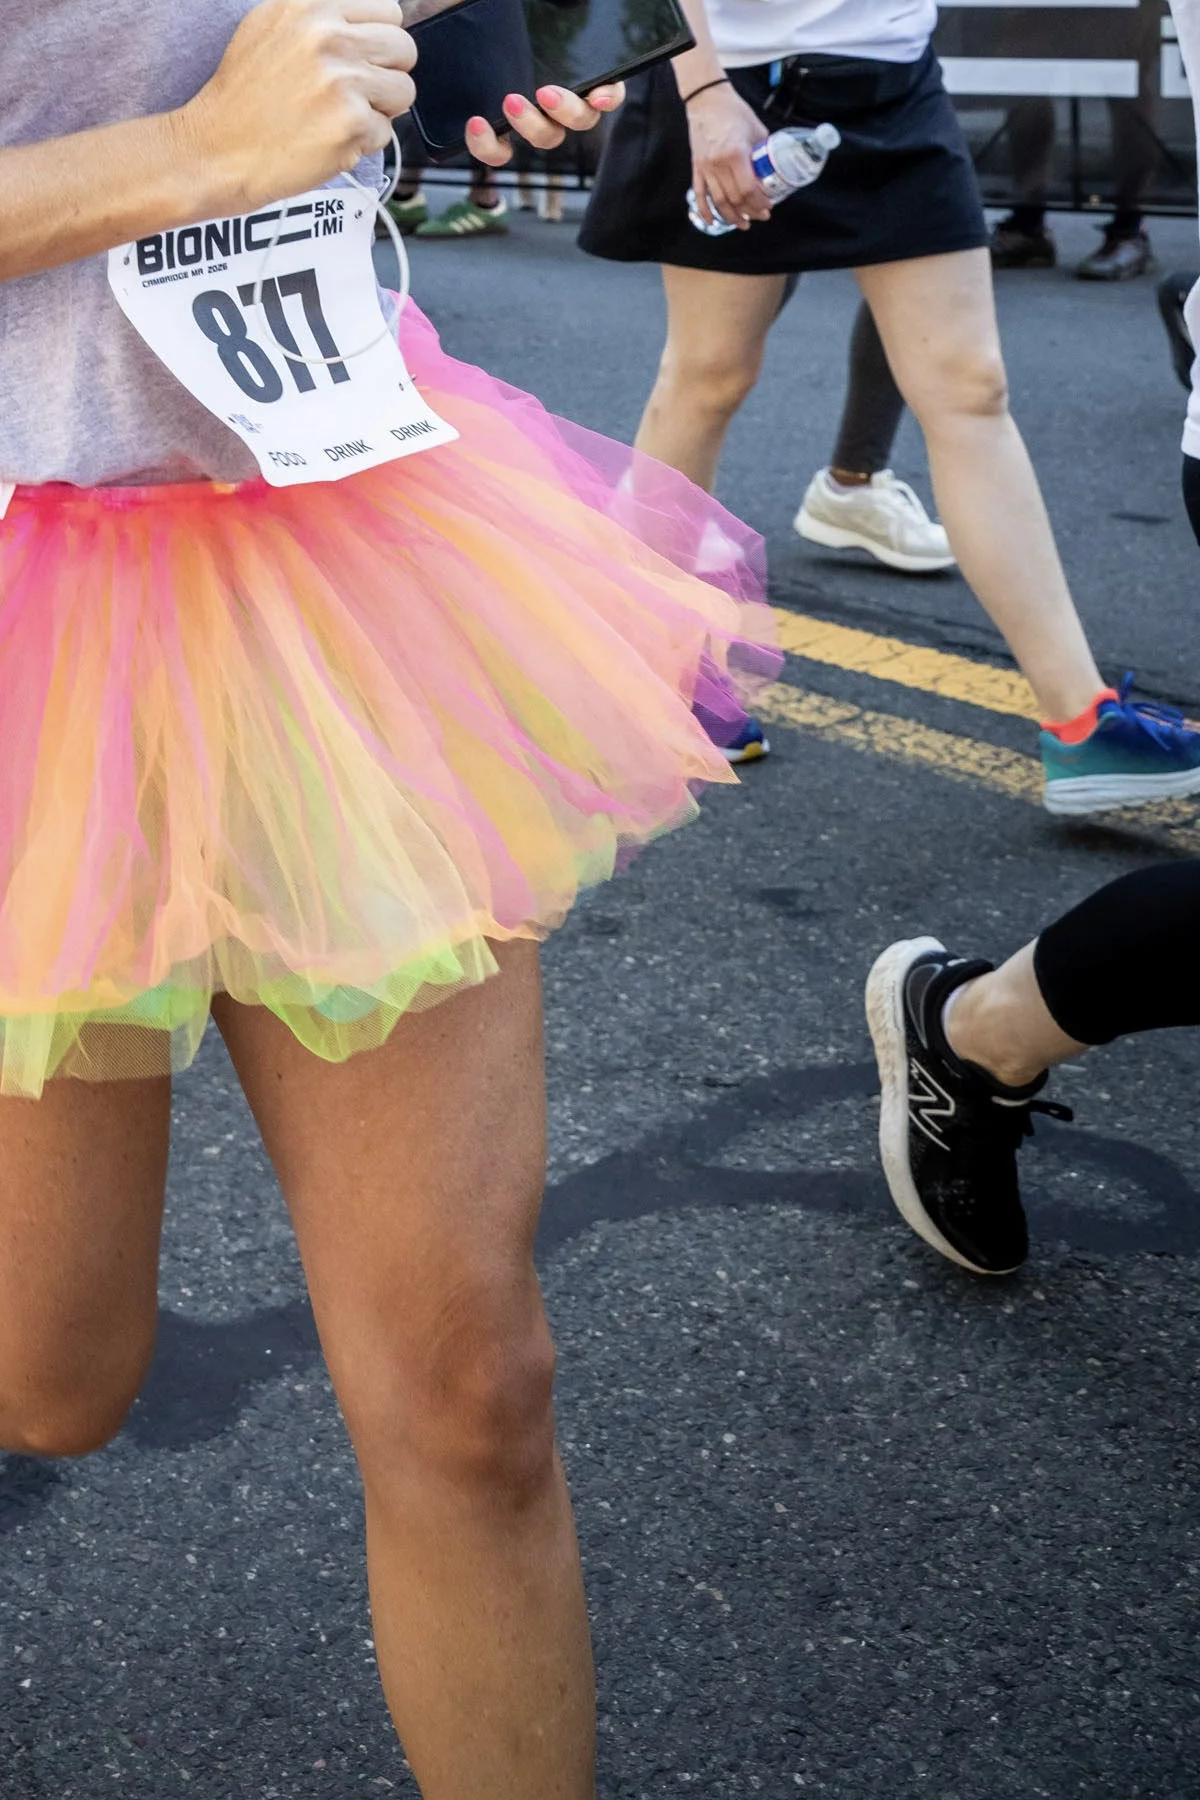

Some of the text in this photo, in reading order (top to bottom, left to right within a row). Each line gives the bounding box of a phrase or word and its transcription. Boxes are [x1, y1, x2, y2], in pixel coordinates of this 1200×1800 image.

[136, 203, 314, 276] BIONIC
[191, 267, 352, 404] 877
[268, 420, 438, 467] FOOD DRINK DRINK
